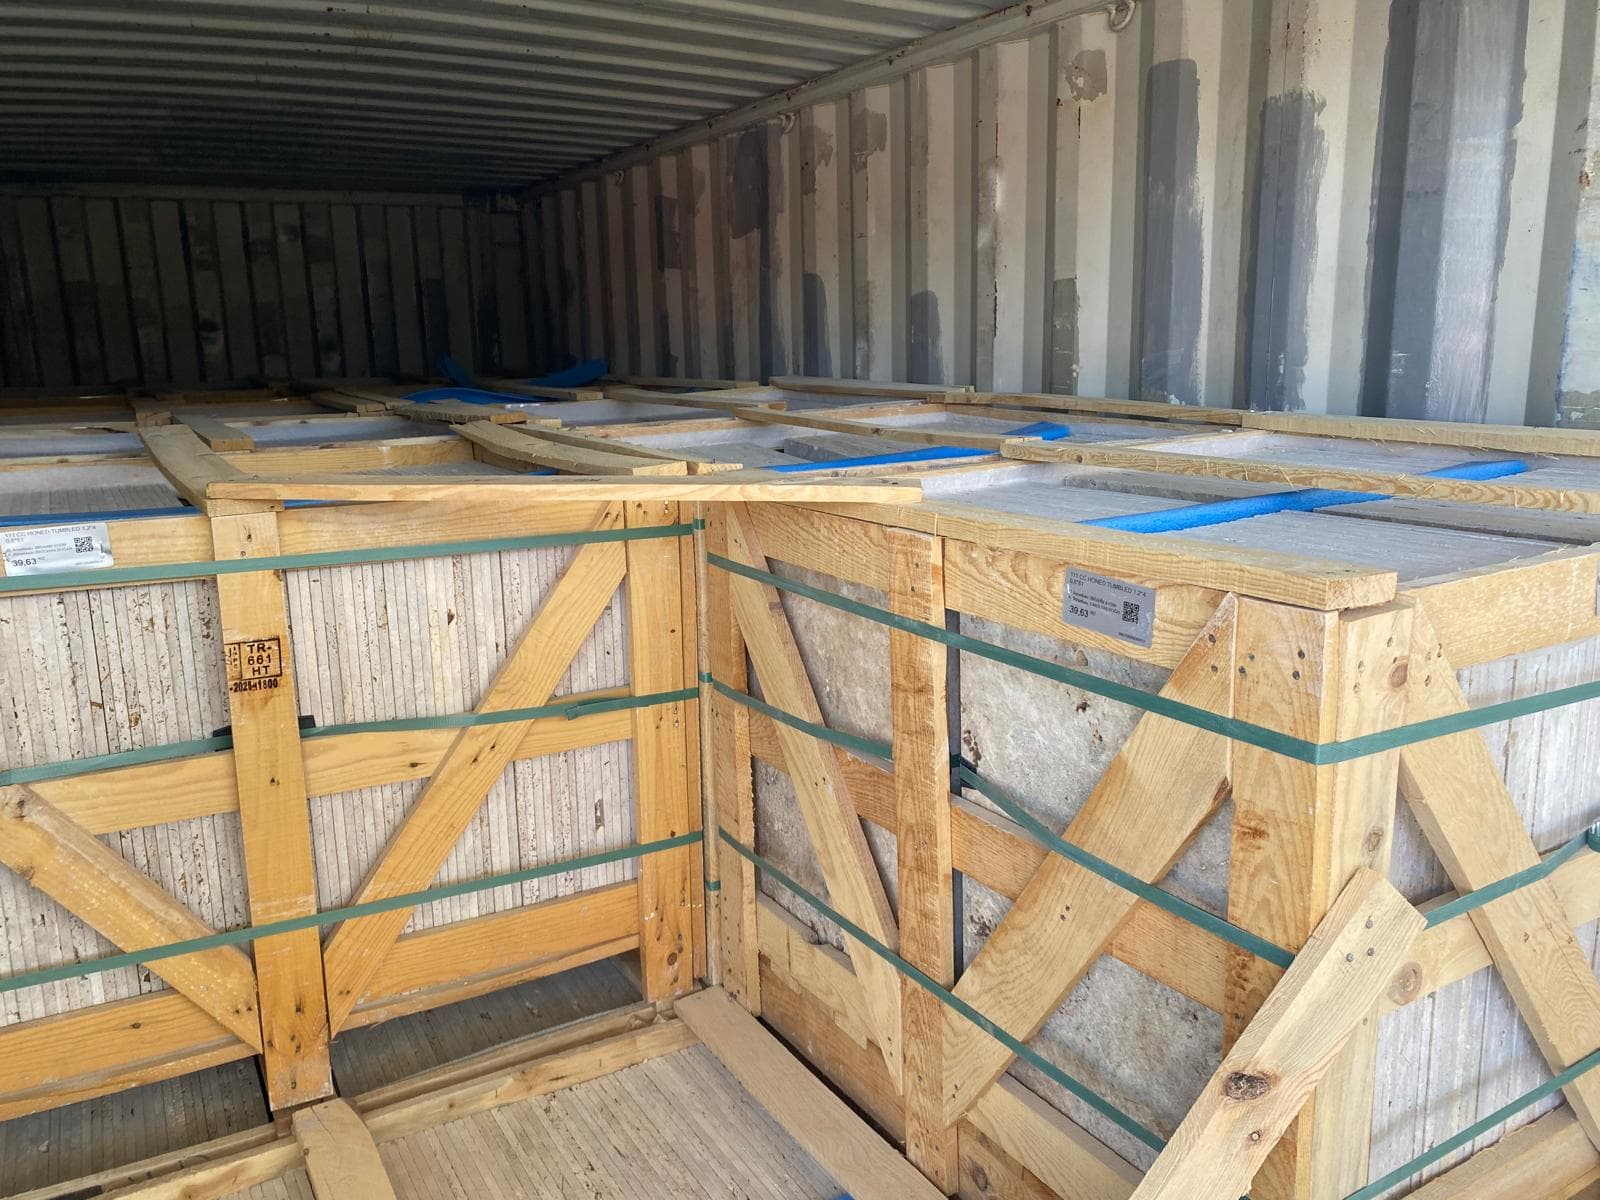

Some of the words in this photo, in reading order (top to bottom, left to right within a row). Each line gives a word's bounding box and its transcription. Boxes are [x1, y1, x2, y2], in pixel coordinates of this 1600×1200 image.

[13, 558, 36, 567] 39,63
[1088, 577, 1106, 585] HONED
[1108, 582, 1132, 594] TUMBLED
[1070, 605, 1088, 618] 39,63
[252, 665, 270, 676] HT
